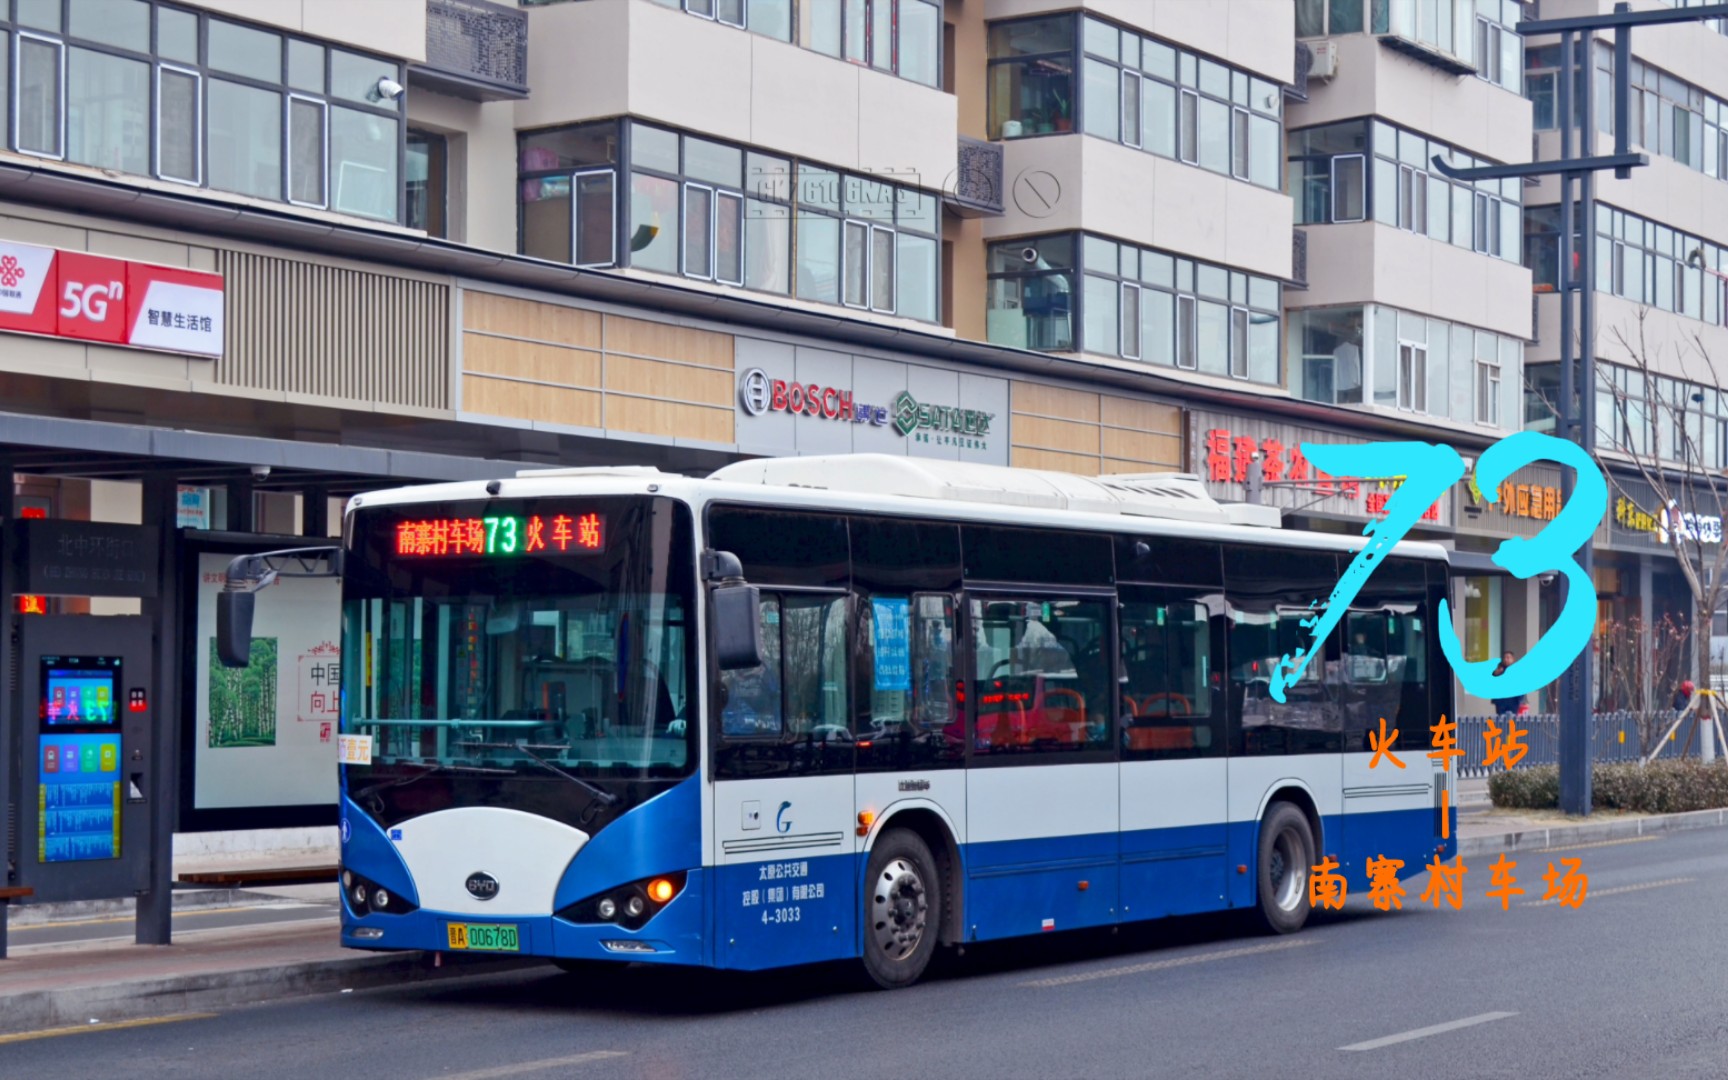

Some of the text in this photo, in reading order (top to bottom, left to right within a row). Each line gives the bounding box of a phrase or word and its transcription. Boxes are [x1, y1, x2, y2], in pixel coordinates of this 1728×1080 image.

[147, 308, 212, 333] 智慧生活馆
[770, 379, 853, 420] BOSCH
[398, 513, 600, 554] 南寨村车场 73 火车站
[310, 662, 340, 686] 中国
[310, 690, 339, 713] 向上
[759, 861, 808, 881] 太原公共交通
[468, 880, 495, 892] BYD
[761, 906, 801, 925] 4-3033
